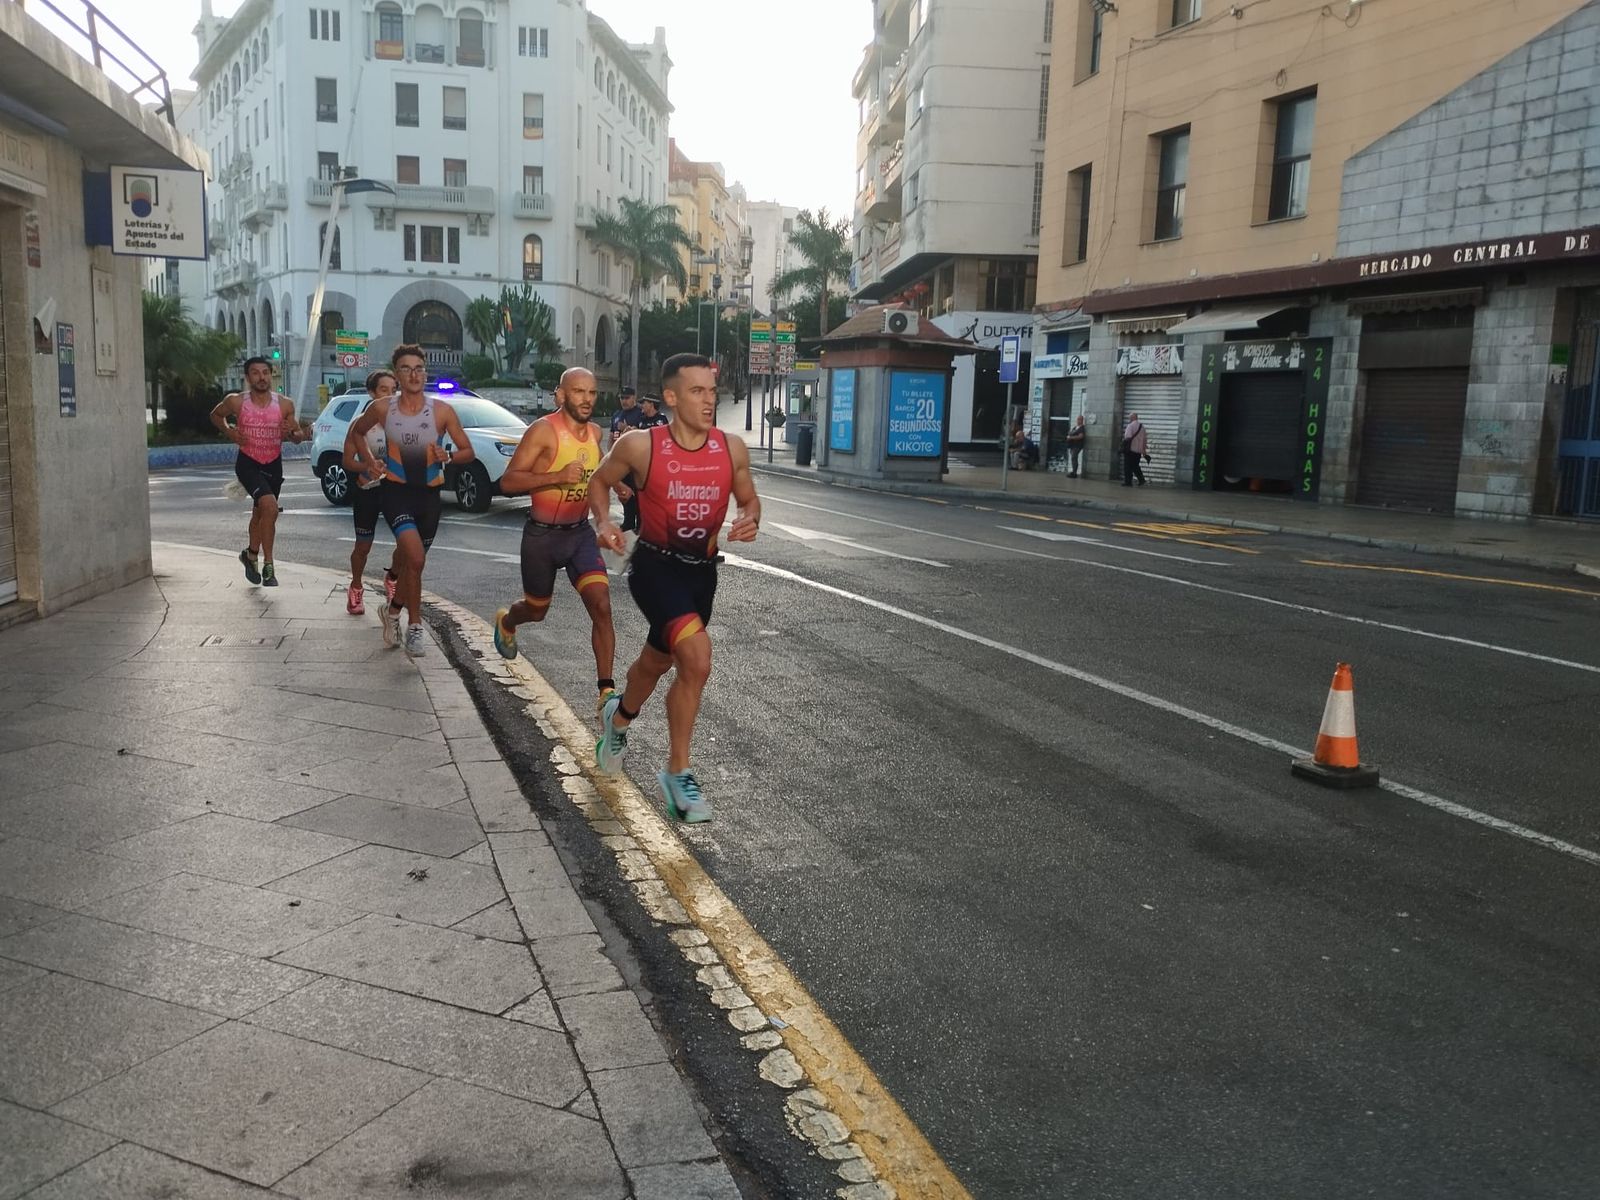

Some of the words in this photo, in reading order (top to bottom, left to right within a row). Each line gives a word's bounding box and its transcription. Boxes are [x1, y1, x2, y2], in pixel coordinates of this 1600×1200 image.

[124, 220, 162, 229] Loterías
[126, 230, 168, 240] Apuestas
[170, 232, 184, 240] del
[125, 240, 157, 248] Estado
[1360, 252, 1432, 276] MERCADO
[1453, 240, 1537, 263] CENTRAL
[1564, 234, 1590, 252] DE
[1242, 344, 1275, 357] NONSTOP
[1250, 356, 1282, 368] MACHINE
[916, 399, 935, 420] 20
[890, 420, 942, 433] SEGUNDOSSS
[401, 432, 419, 445] UBAY
[1199, 404, 1212, 483] HORAS
[1303, 404, 1319, 492] HORAS
[667, 480, 720, 500] Albarracín
[676, 503, 710, 520] ESP
